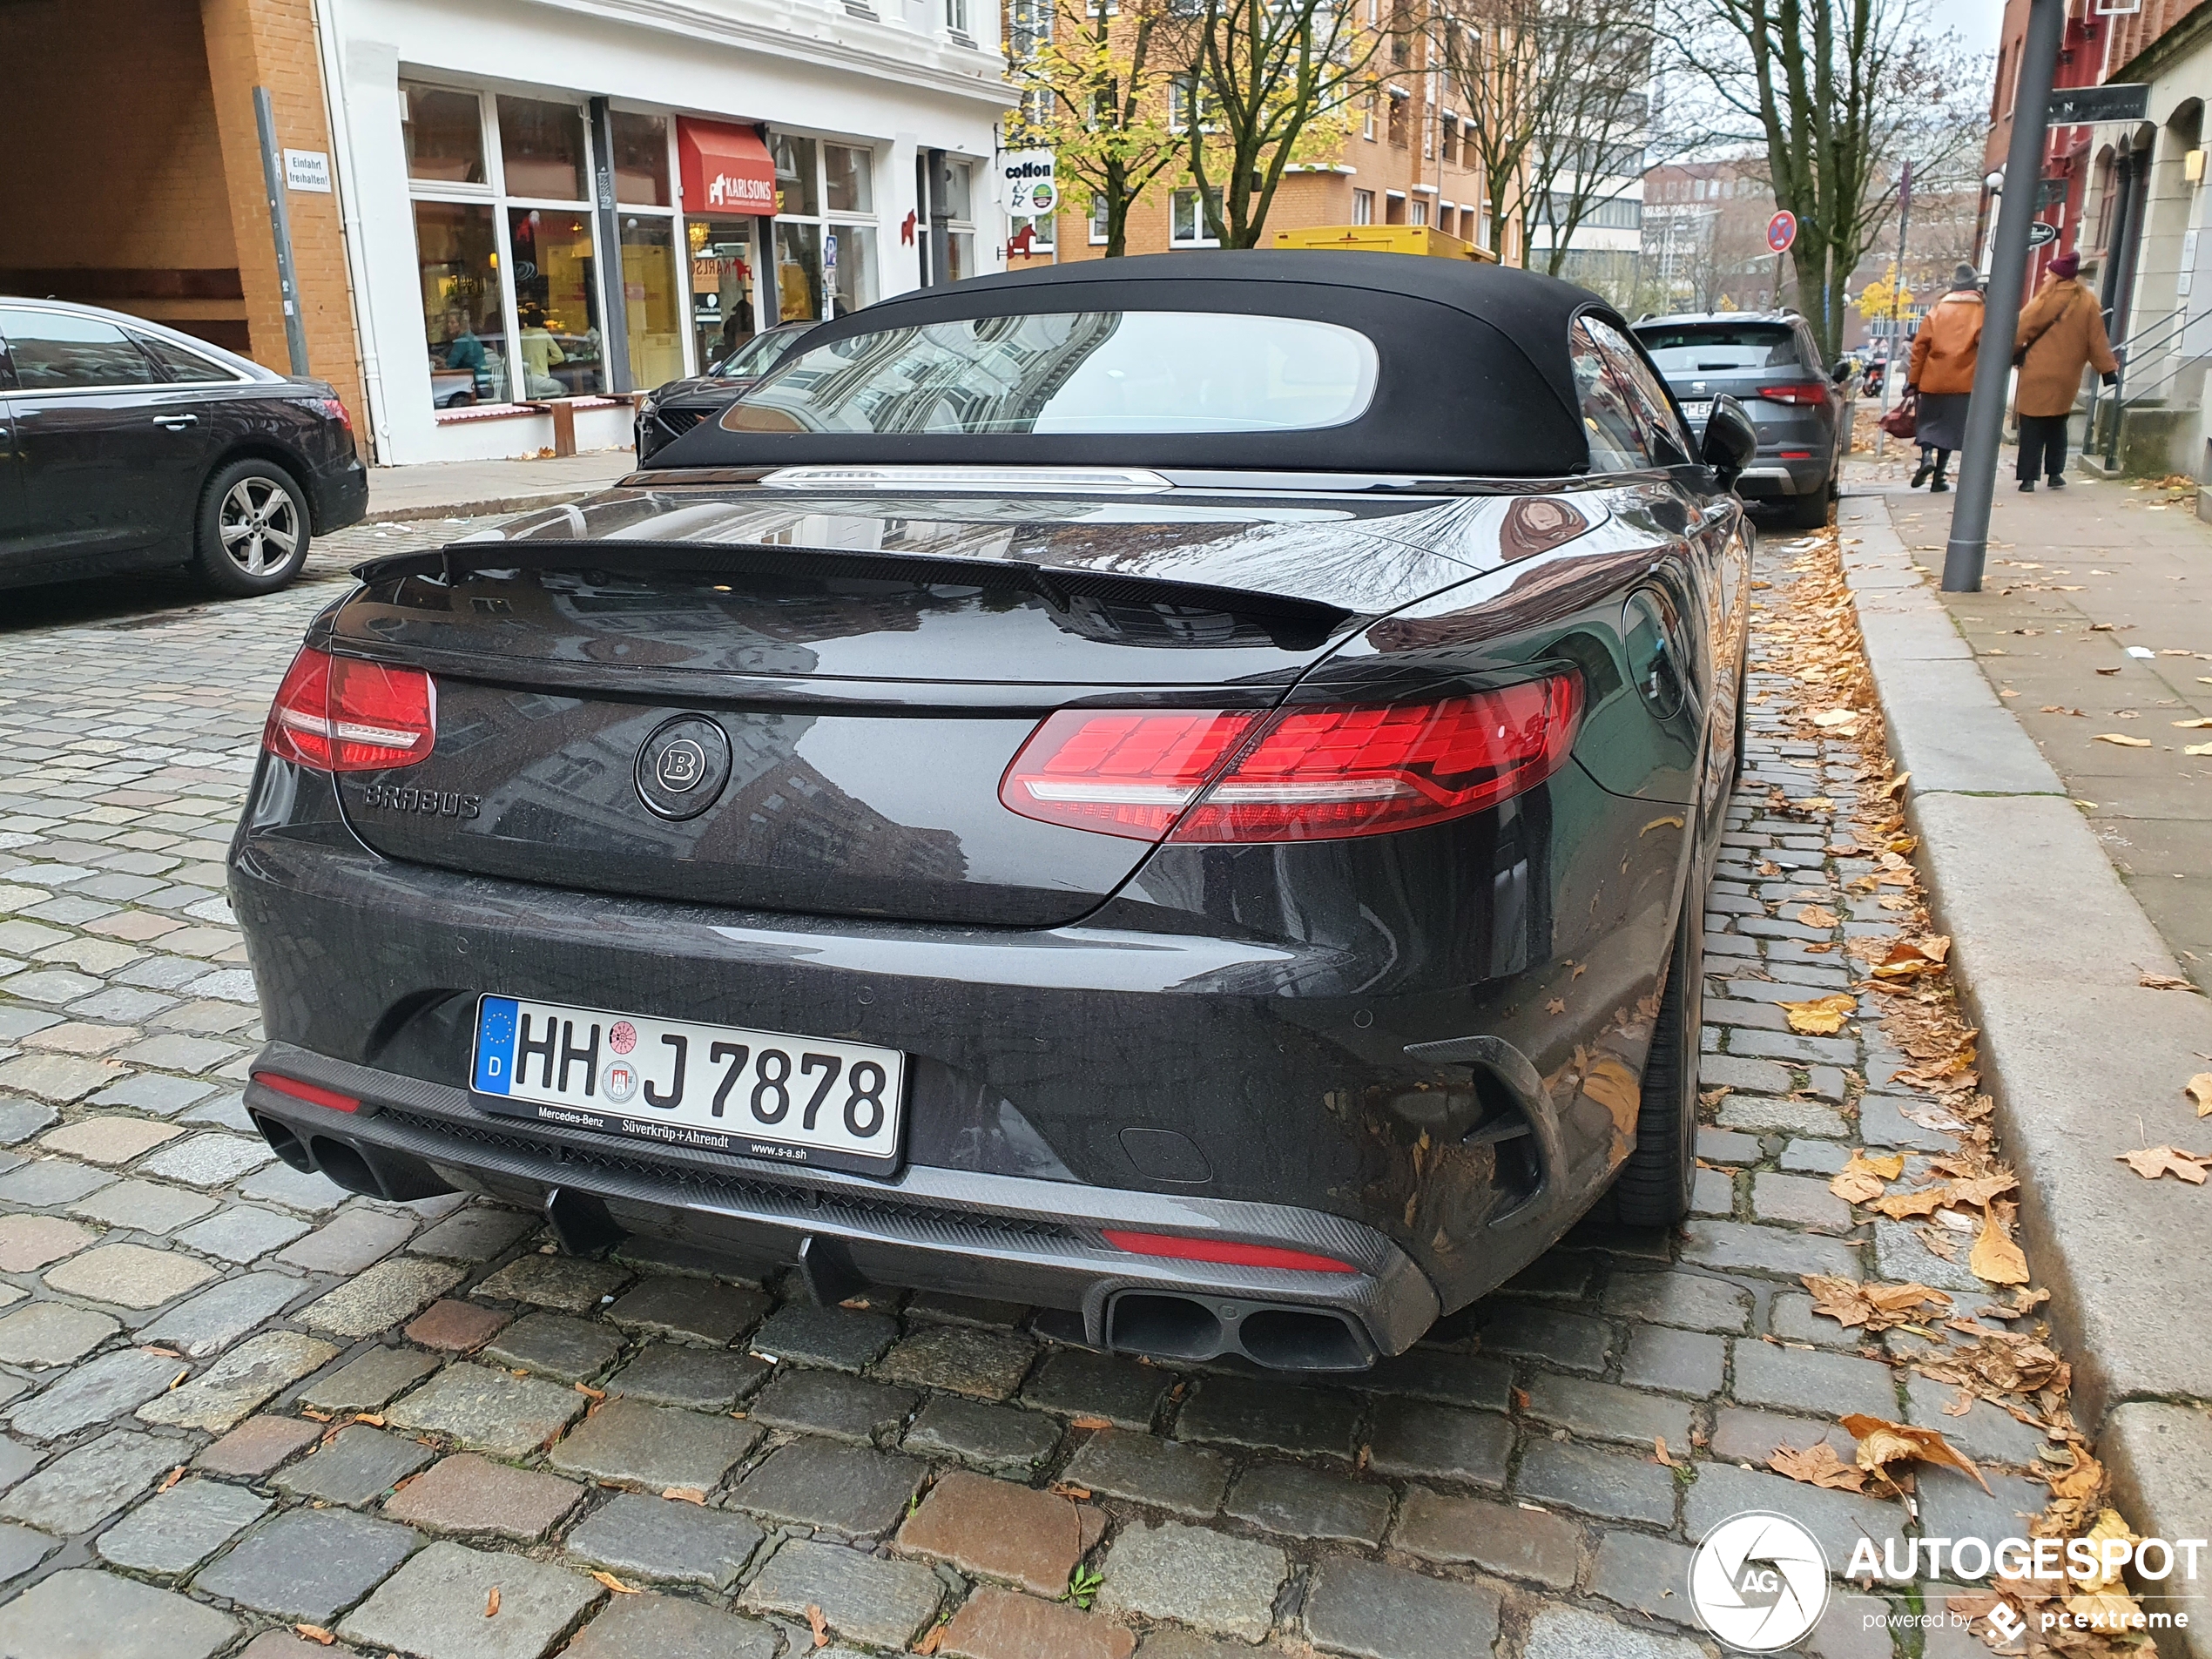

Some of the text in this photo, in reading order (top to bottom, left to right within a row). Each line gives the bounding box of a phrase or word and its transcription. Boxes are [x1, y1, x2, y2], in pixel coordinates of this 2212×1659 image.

[293, 158, 321, 170] Einfahrt
[289, 172, 327, 185] freihalten!
[725, 177, 772, 200] KARLSONS
[664, 749, 696, 780] B
[363, 785, 482, 818] BRABUS
[488, 1055, 502, 1076] D
[516, 1013, 601, 1096] HH
[643, 1034, 688, 1109] J
[709, 1041, 887, 1138] 7878
[538, 1106, 807, 1160] Mercedes-Benz Süverkrüp+Ahrendt www.s-a.sh
